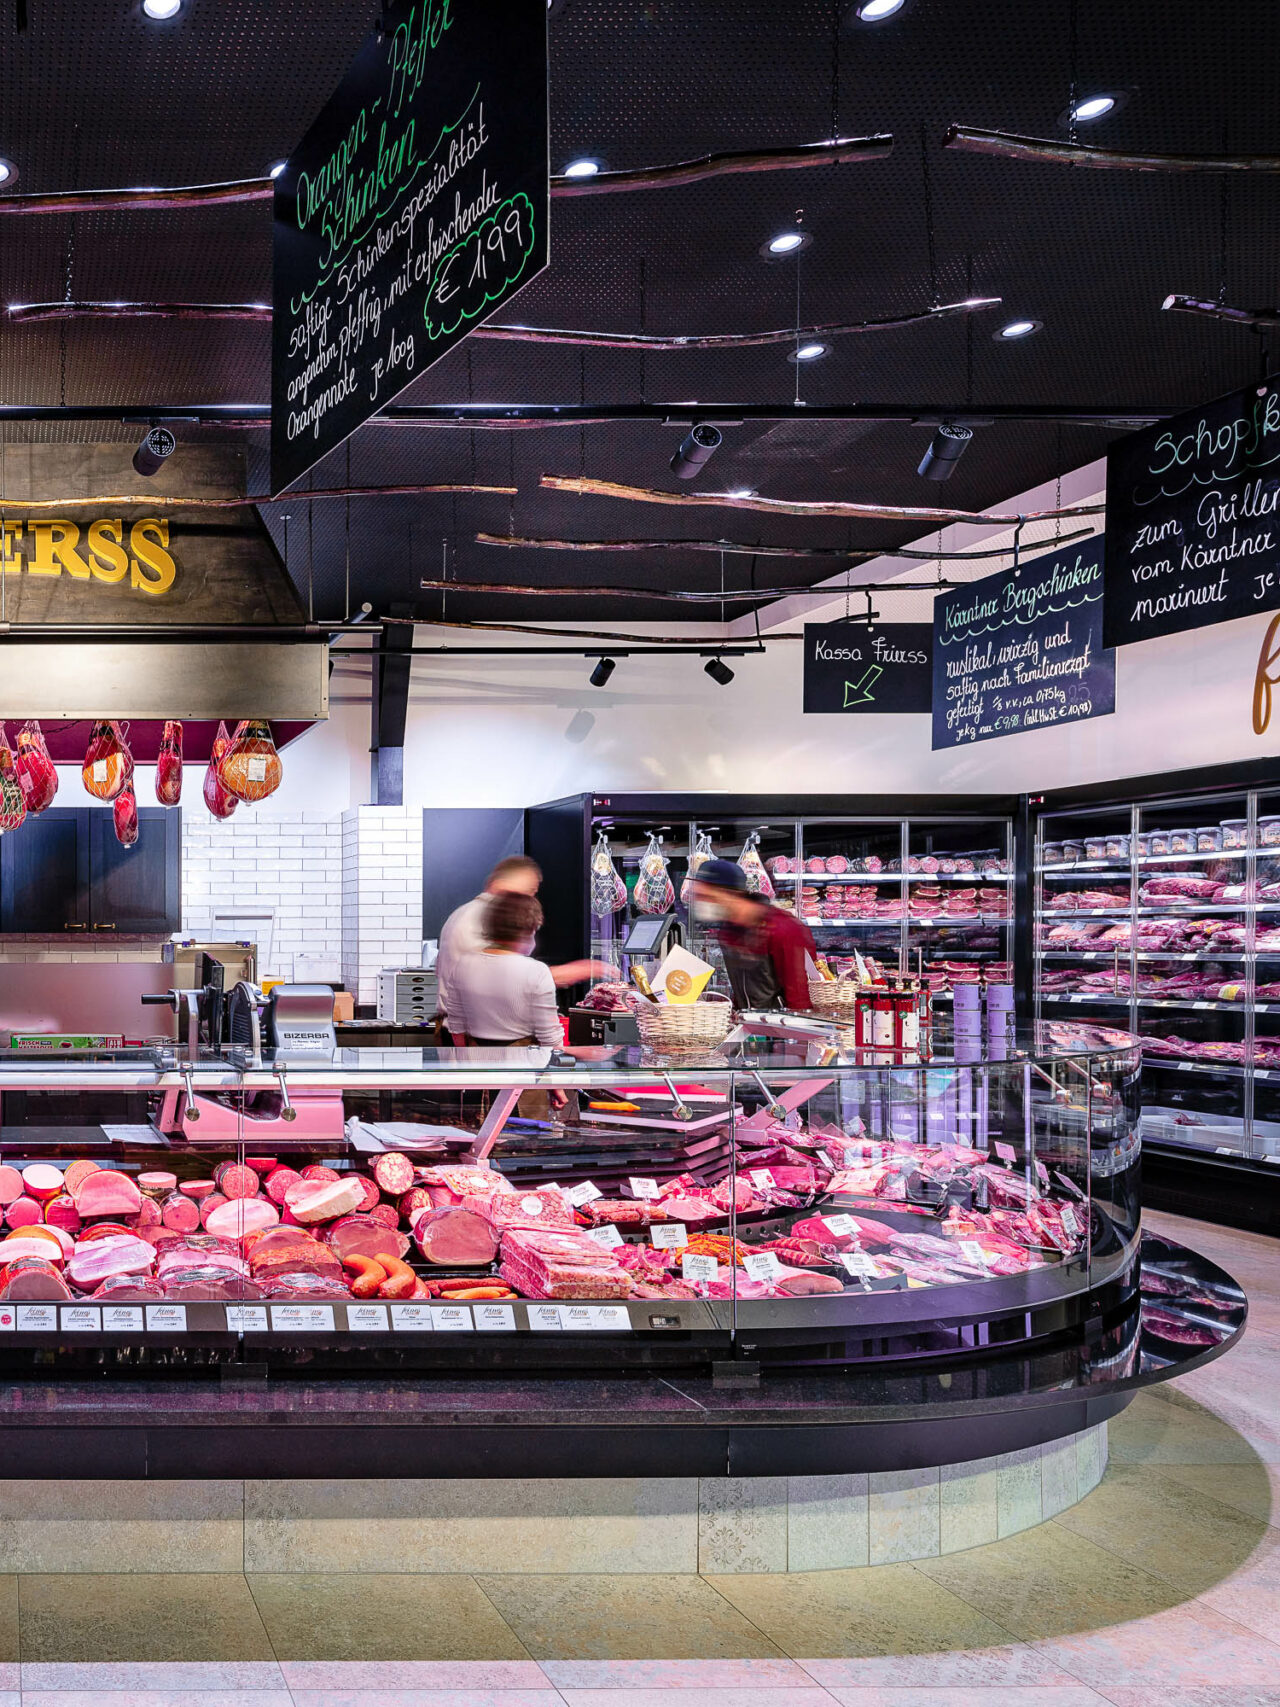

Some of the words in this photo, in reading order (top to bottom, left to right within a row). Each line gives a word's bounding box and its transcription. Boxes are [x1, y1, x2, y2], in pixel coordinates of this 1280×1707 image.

[319, 118, 418, 269] Schinken
[287, 335, 339, 406] angenehm
[414, 168, 502, 285] erfrischender
[288, 297, 333, 358] saftige
[287, 361, 358, 441] Orangennote
[1131, 518, 1183, 554] zum
[1131, 559, 1175, 584] vom
[1180, 527, 1277, 571] Kärntner
[945, 594, 999, 632] Kärntner
[1002, 554, 1103, 619] Bergschinken
[1130, 568, 1230, 622] mariniert
[815, 640, 863, 662] Kassa
[1045, 621, 1073, 649] und
[946, 675, 979, 703] saftig
[981, 668, 1012, 692] nach
[1014, 640, 1091, 681] Familienrezept
[946, 697, 984, 729] gefertigt
[283, 1032, 330, 1040] BIZERBA
